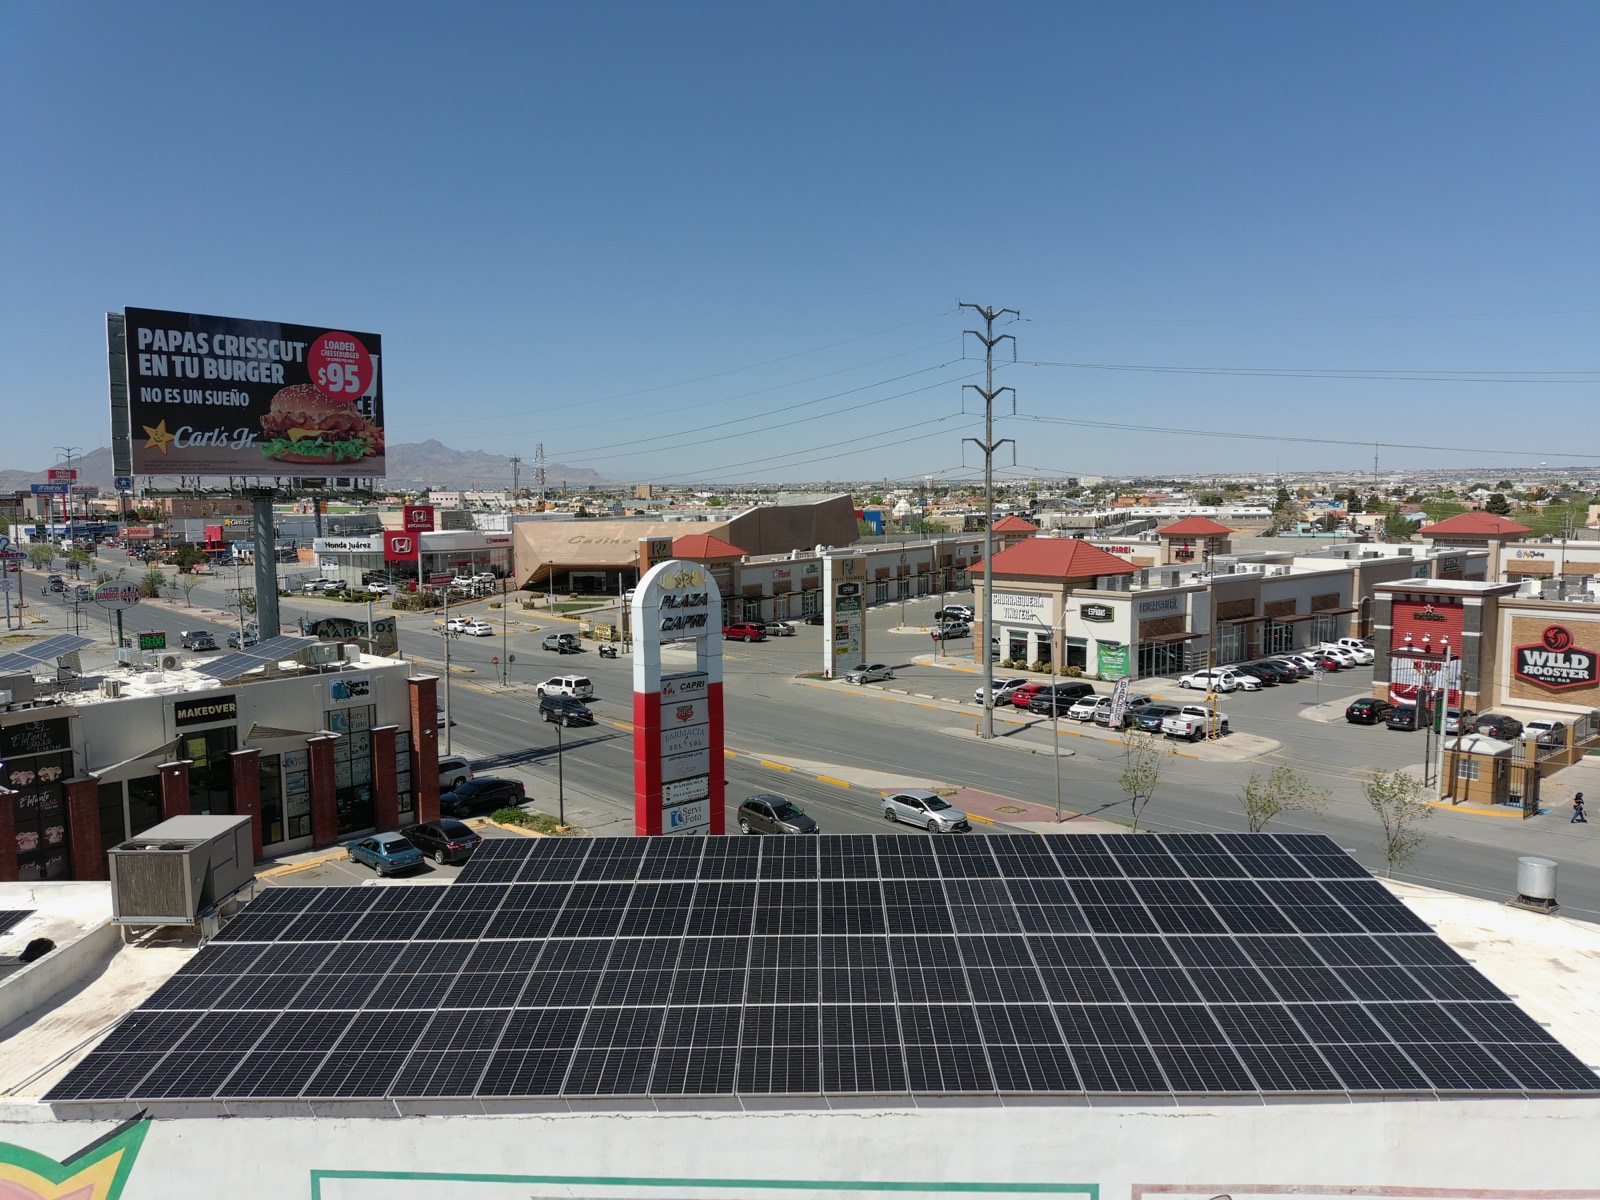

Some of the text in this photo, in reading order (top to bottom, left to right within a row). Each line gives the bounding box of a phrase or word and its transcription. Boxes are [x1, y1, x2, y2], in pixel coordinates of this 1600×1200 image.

[137, 327, 304, 363] PAPAS CRISSCUT
[324, 340, 355, 351] LOADED
[138, 353, 285, 385] EN TU BURGER
[317, 362, 360, 393] $95
[140, 387, 250, 407] NO ES UN SUEÑO
[173, 426, 257, 450] Carl's Jr.
[324, 541, 371, 551] Honda Juárez
[568, 535, 631, 545] Casino
[660, 593, 708, 609] PLAZA
[661, 613, 708, 631] CAPRI
[317, 624, 393, 638] MARISOS
[1524, 650, 1590, 669] WILD
[1523, 665, 1589, 679] ROOSTER
[346, 680, 369, 689] Servi
[680, 681, 705, 690] CAPRI
[348, 688, 369, 697] Foto
[178, 703, 236, 719] MAKEOVER
[665, 728, 705, 742] FARMACIA
[683, 803, 702, 815] Servi
[685, 814, 702, 824] Foto
